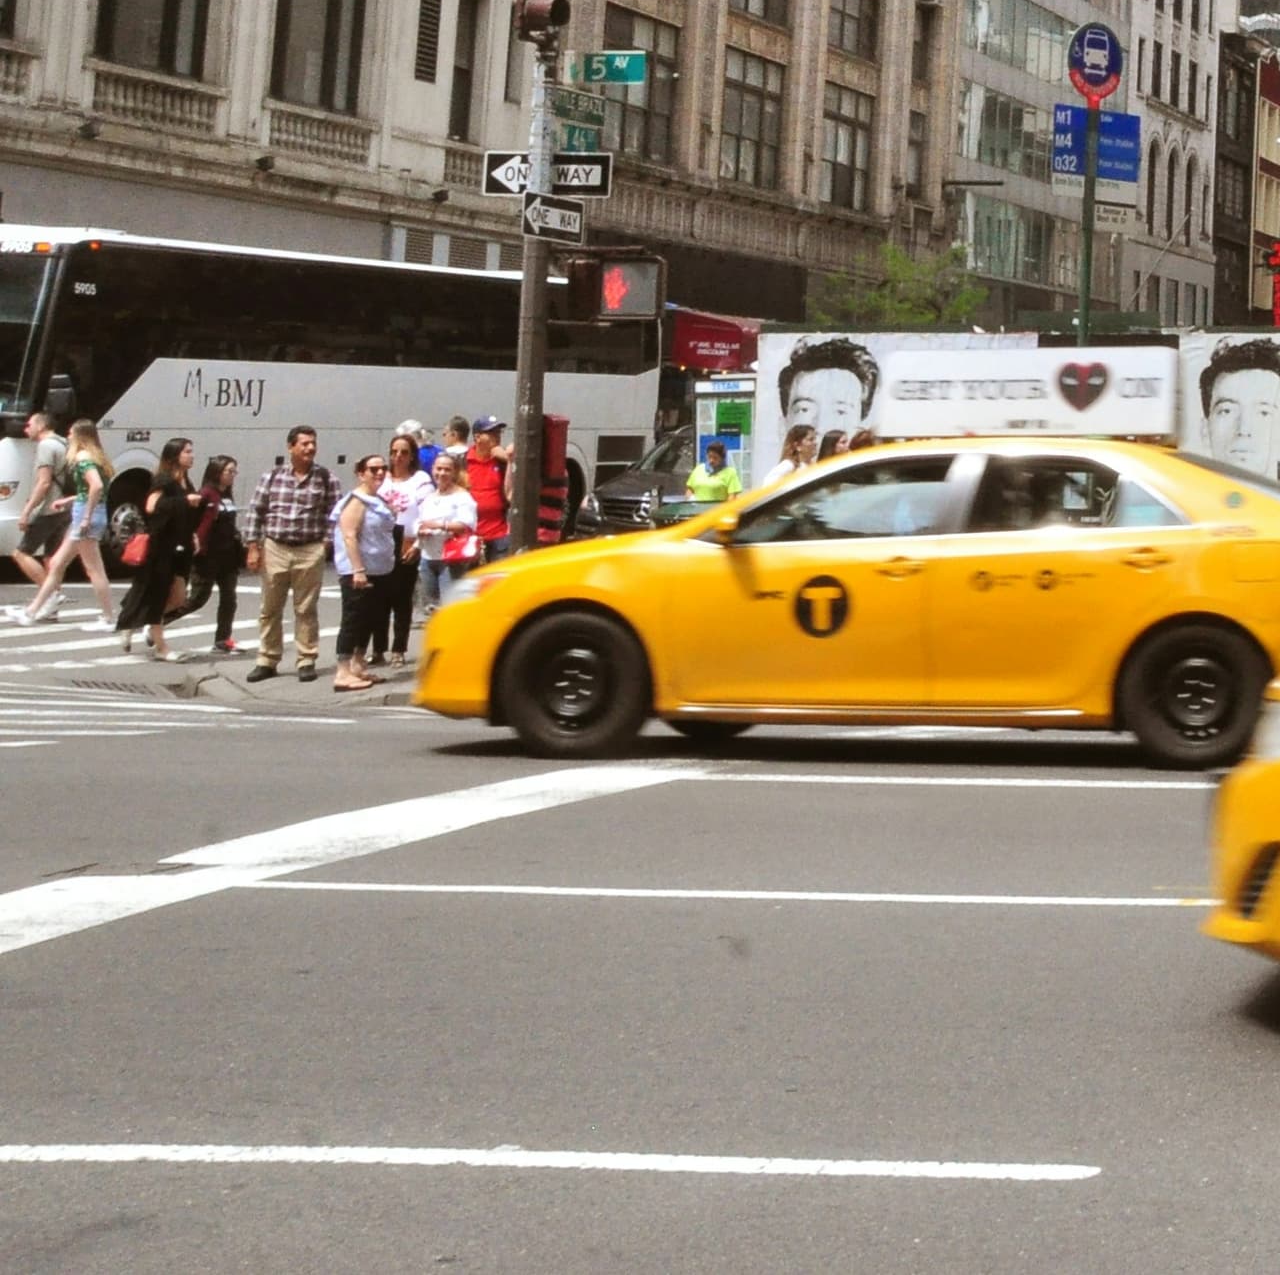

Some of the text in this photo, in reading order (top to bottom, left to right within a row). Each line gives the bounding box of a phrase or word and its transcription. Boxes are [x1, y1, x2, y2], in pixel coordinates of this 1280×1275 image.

[591, 56, 630, 80] 5 AV
[1055, 110, 1072, 125] M1
[1055, 133, 1073, 148] M4
[504, 166, 594, 183] ON WAY
[531, 205, 579, 231] ONE WAY
[183, 368, 266, 417] Mr BMJ
